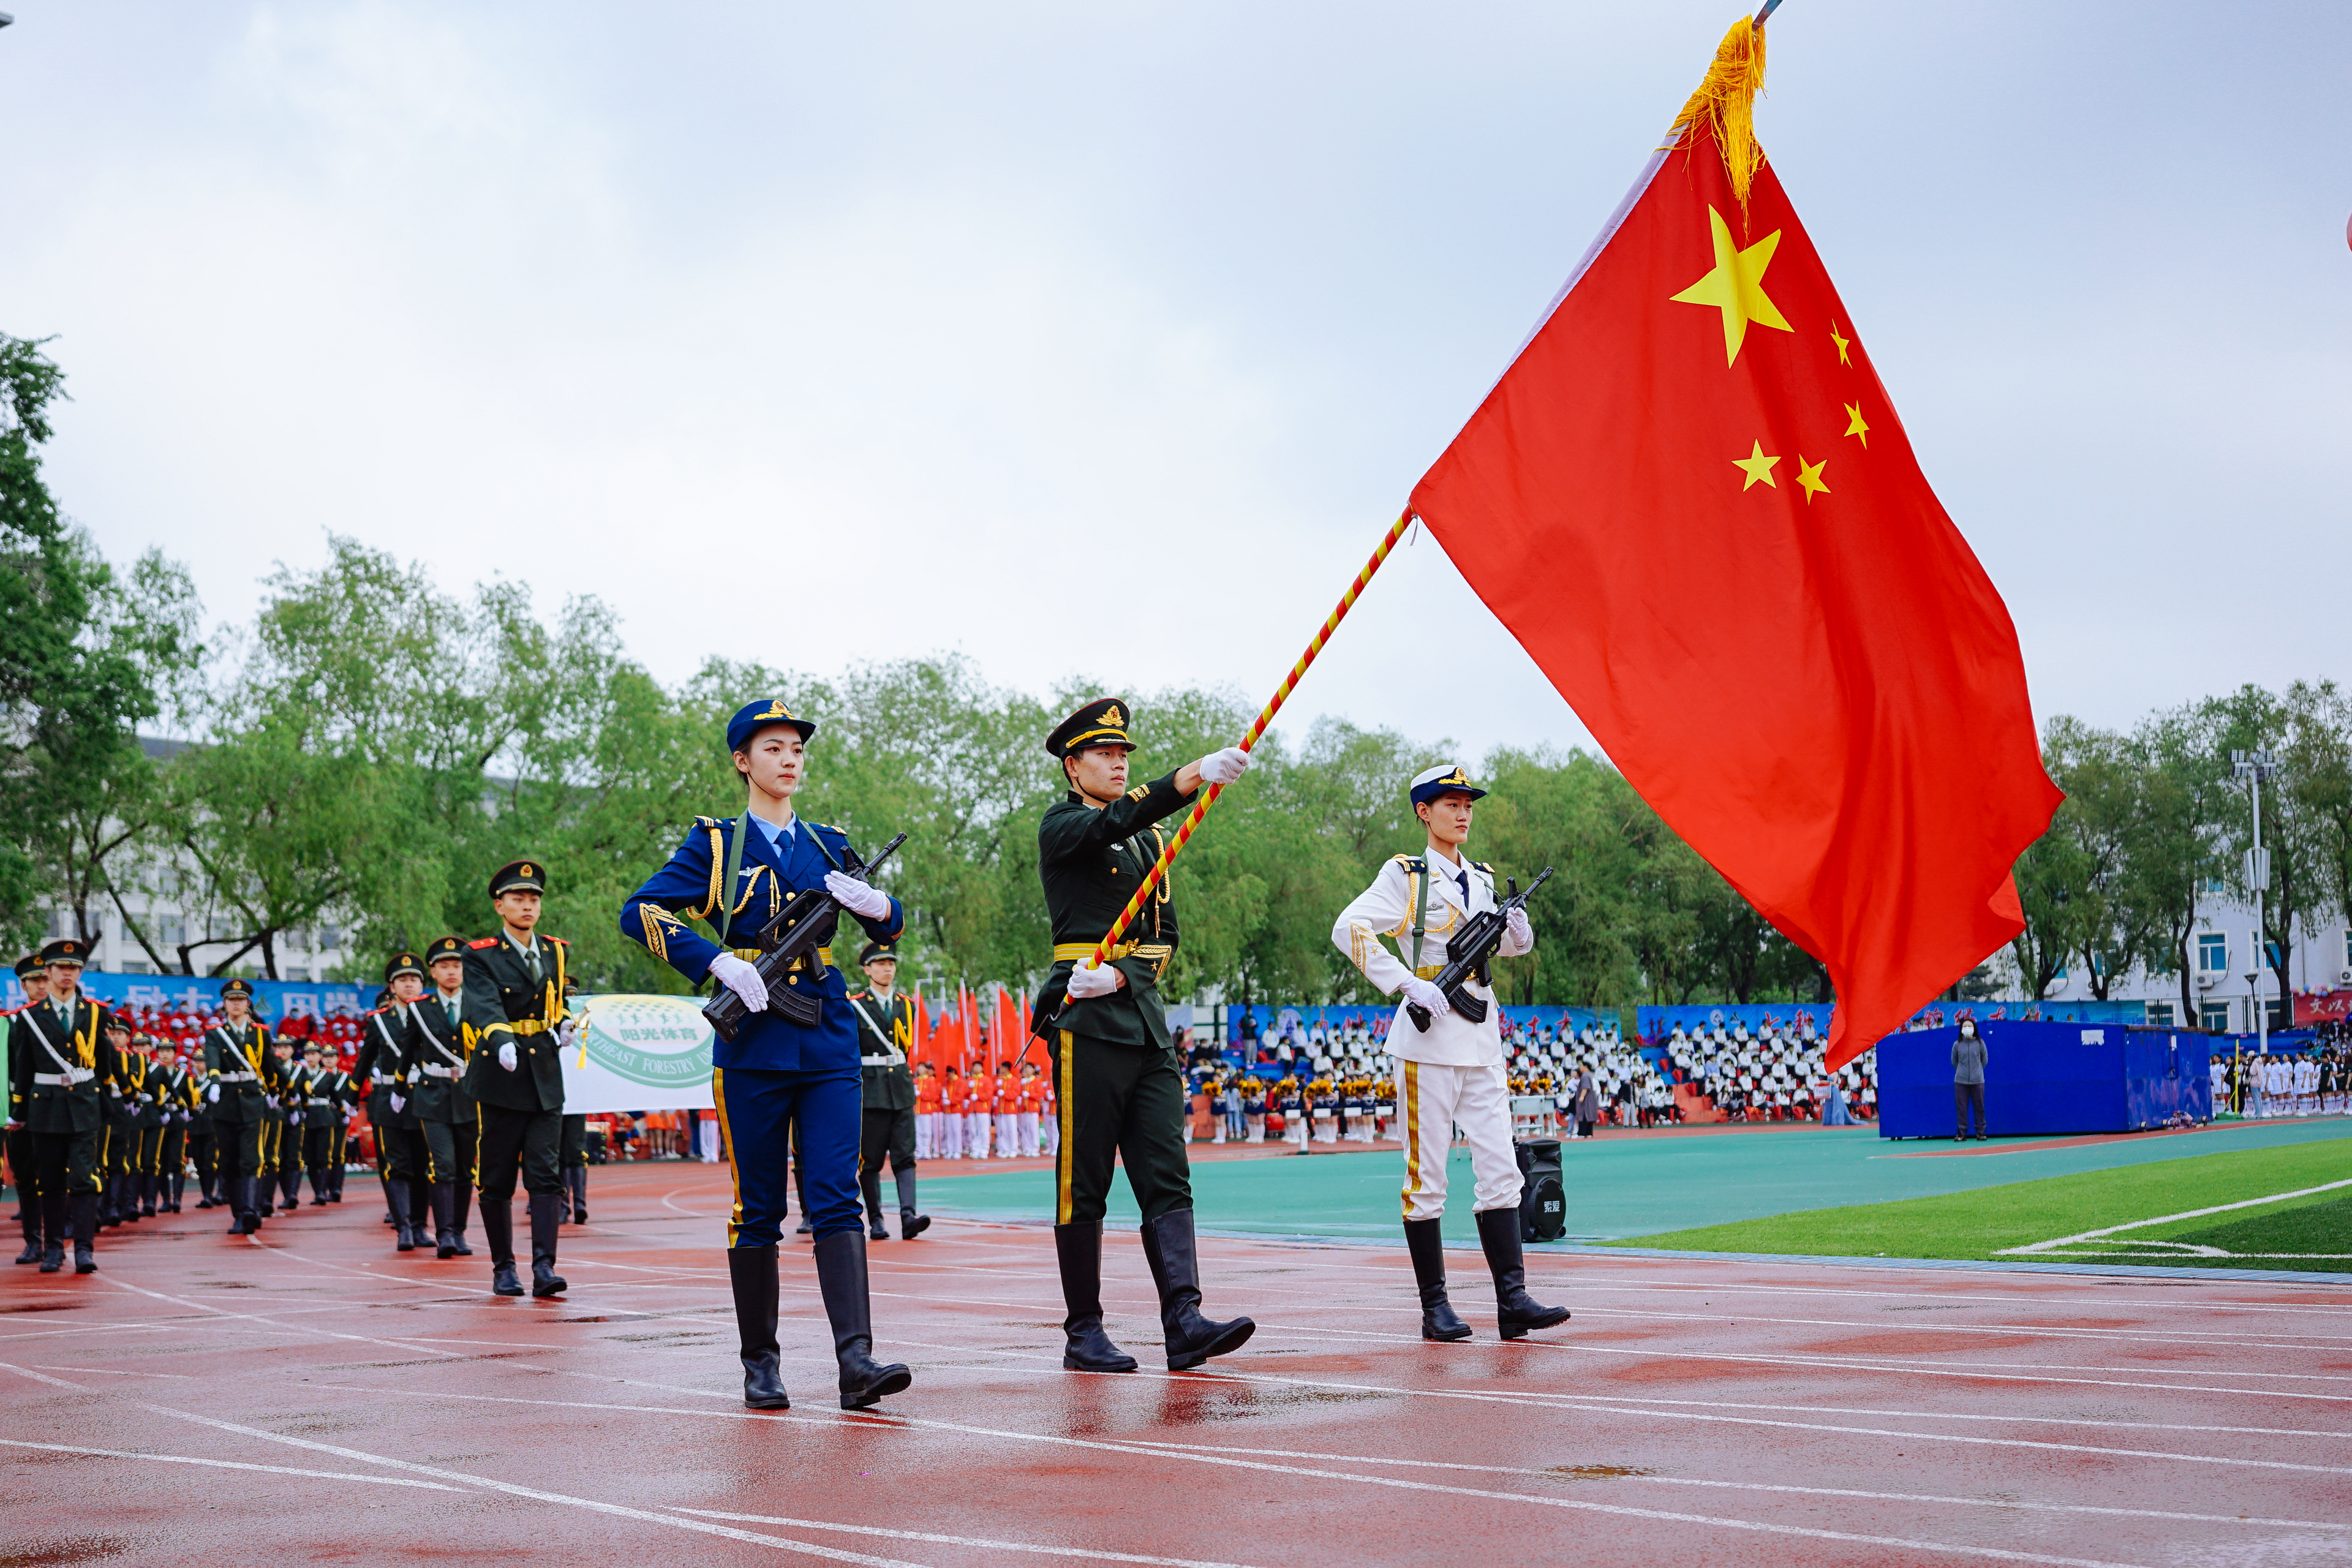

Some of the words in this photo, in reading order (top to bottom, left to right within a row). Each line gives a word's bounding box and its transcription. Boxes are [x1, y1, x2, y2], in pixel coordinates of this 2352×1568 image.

[619, 1027, 699, 1041] 阳光体育
[577, 1028, 638, 1066] ORTHEAST
[643, 1057, 696, 1074] FORESTRY
[1544, 1200, 1561, 1213] 索爱
